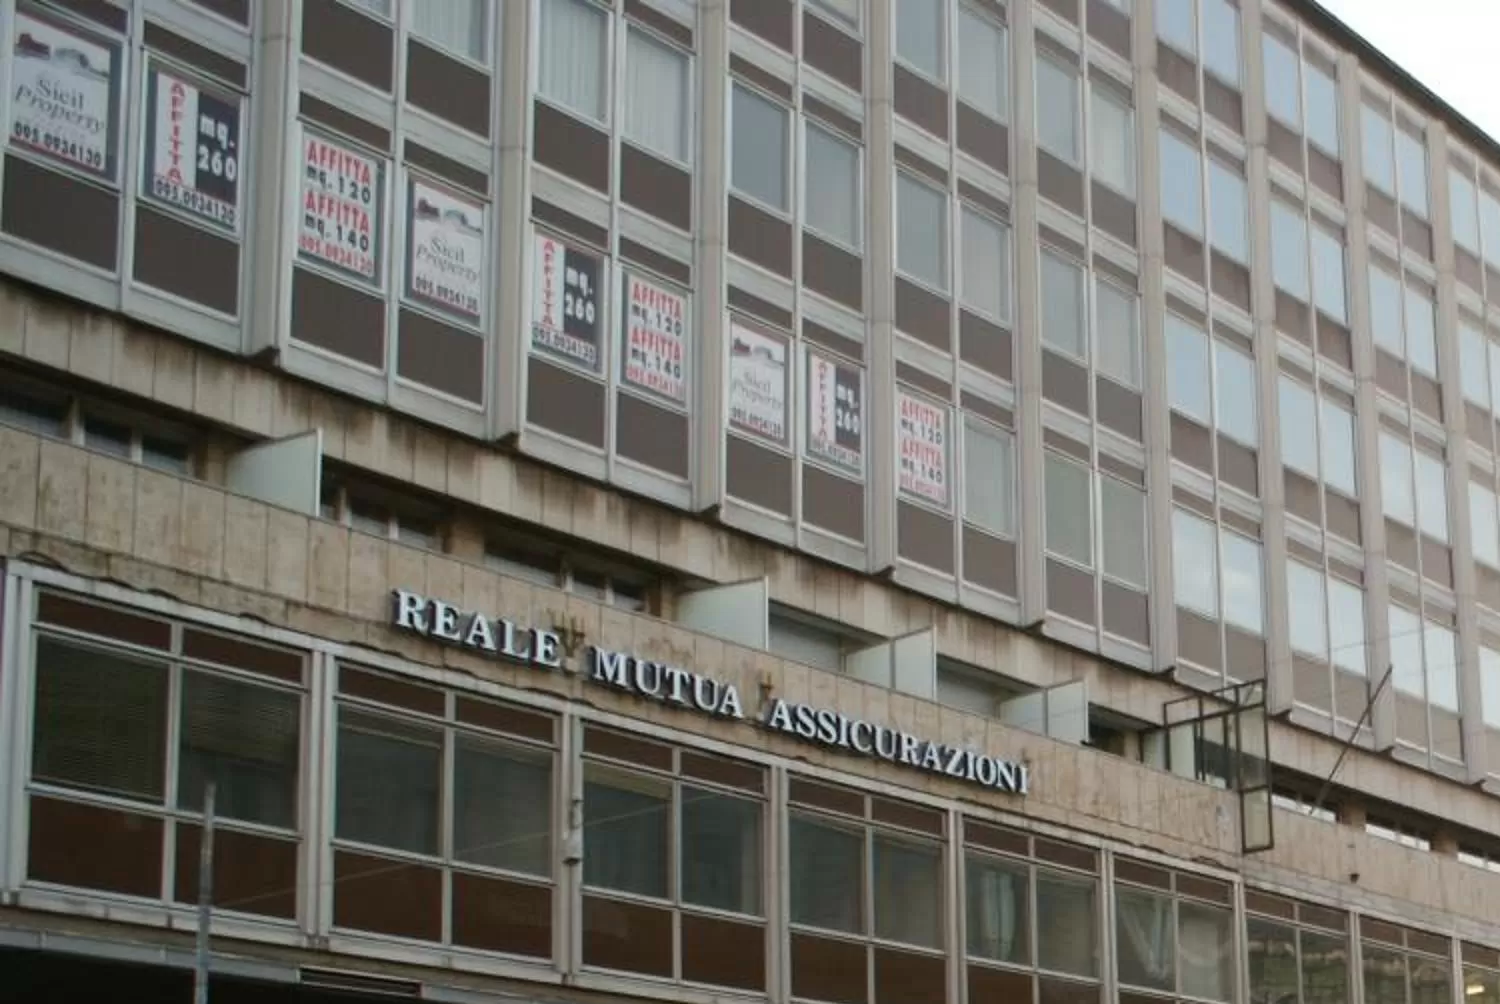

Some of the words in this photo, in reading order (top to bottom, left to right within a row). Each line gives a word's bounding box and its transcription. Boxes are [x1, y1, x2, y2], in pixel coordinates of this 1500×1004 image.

[170, 82, 185, 185] AFFITTA
[200, 113, 236, 151] mq.
[198, 144, 236, 182] 260
[307, 139, 371, 185] AFFITTA
[306, 165, 333, 190] mq.
[338, 175, 371, 205] 120
[306, 189, 369, 233] AFFITTA
[304, 213, 331, 241] mq.
[337, 223, 369, 253] 140
[565, 291, 595, 325] 260
[632, 281, 683, 322] AFFITTA
[656, 311, 683, 337] 120
[632, 325, 682, 364] AFFITTA
[655, 353, 682, 379] 140
[836, 406, 861, 435] 260
[901, 398, 943, 432] AFFITTA
[920, 421, 944, 447] 120
[901, 437, 943, 472] AFFITTA
[921, 462, 944, 486] 140
[393, 589, 562, 668] REALE
[592, 645, 744, 719] MUTUA
[768, 699, 1029, 795] ASSICURAZIONI
